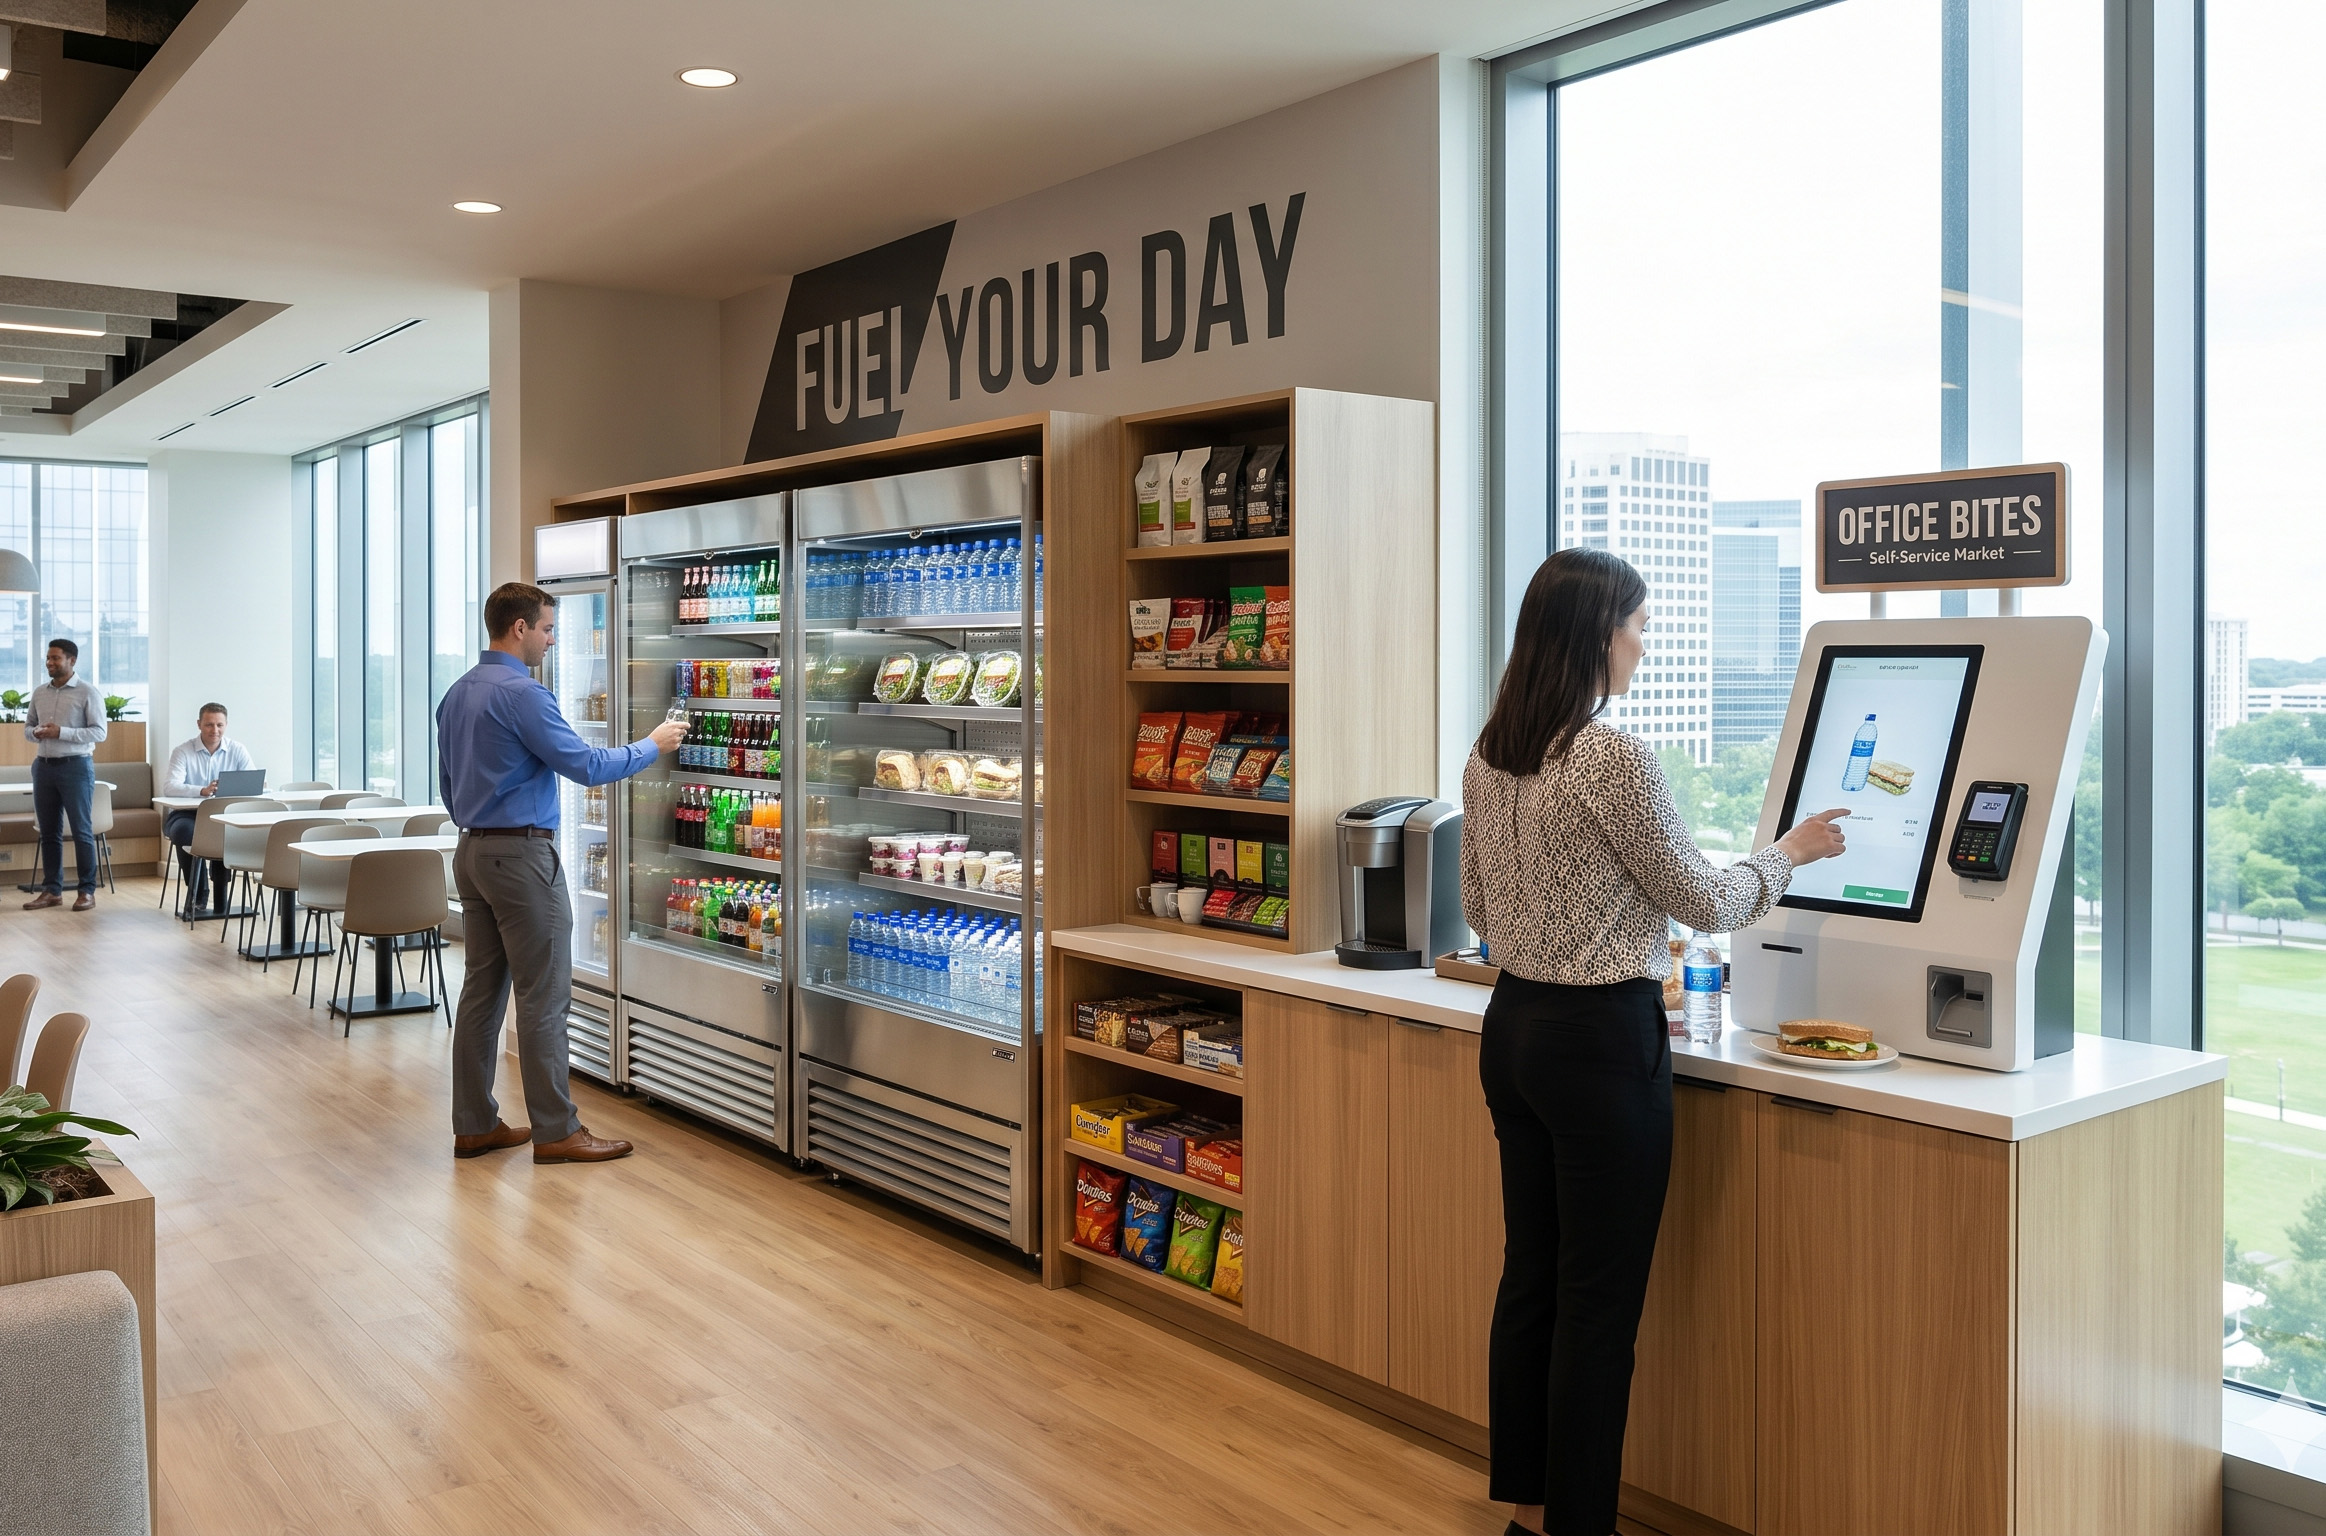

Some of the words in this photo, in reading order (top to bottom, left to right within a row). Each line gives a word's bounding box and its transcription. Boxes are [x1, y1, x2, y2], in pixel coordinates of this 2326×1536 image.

[795, 305, 905, 431] FUEL
[936, 251, 1110, 401] YOUR
[1141, 191, 1307, 363] DAY
[1838, 501, 1939, 546] OFFICE
[1950, 494, 2042, 540] BITES
[1869, 548, 1950, 565] Self-Service
[1954, 545, 2005, 561] Market
